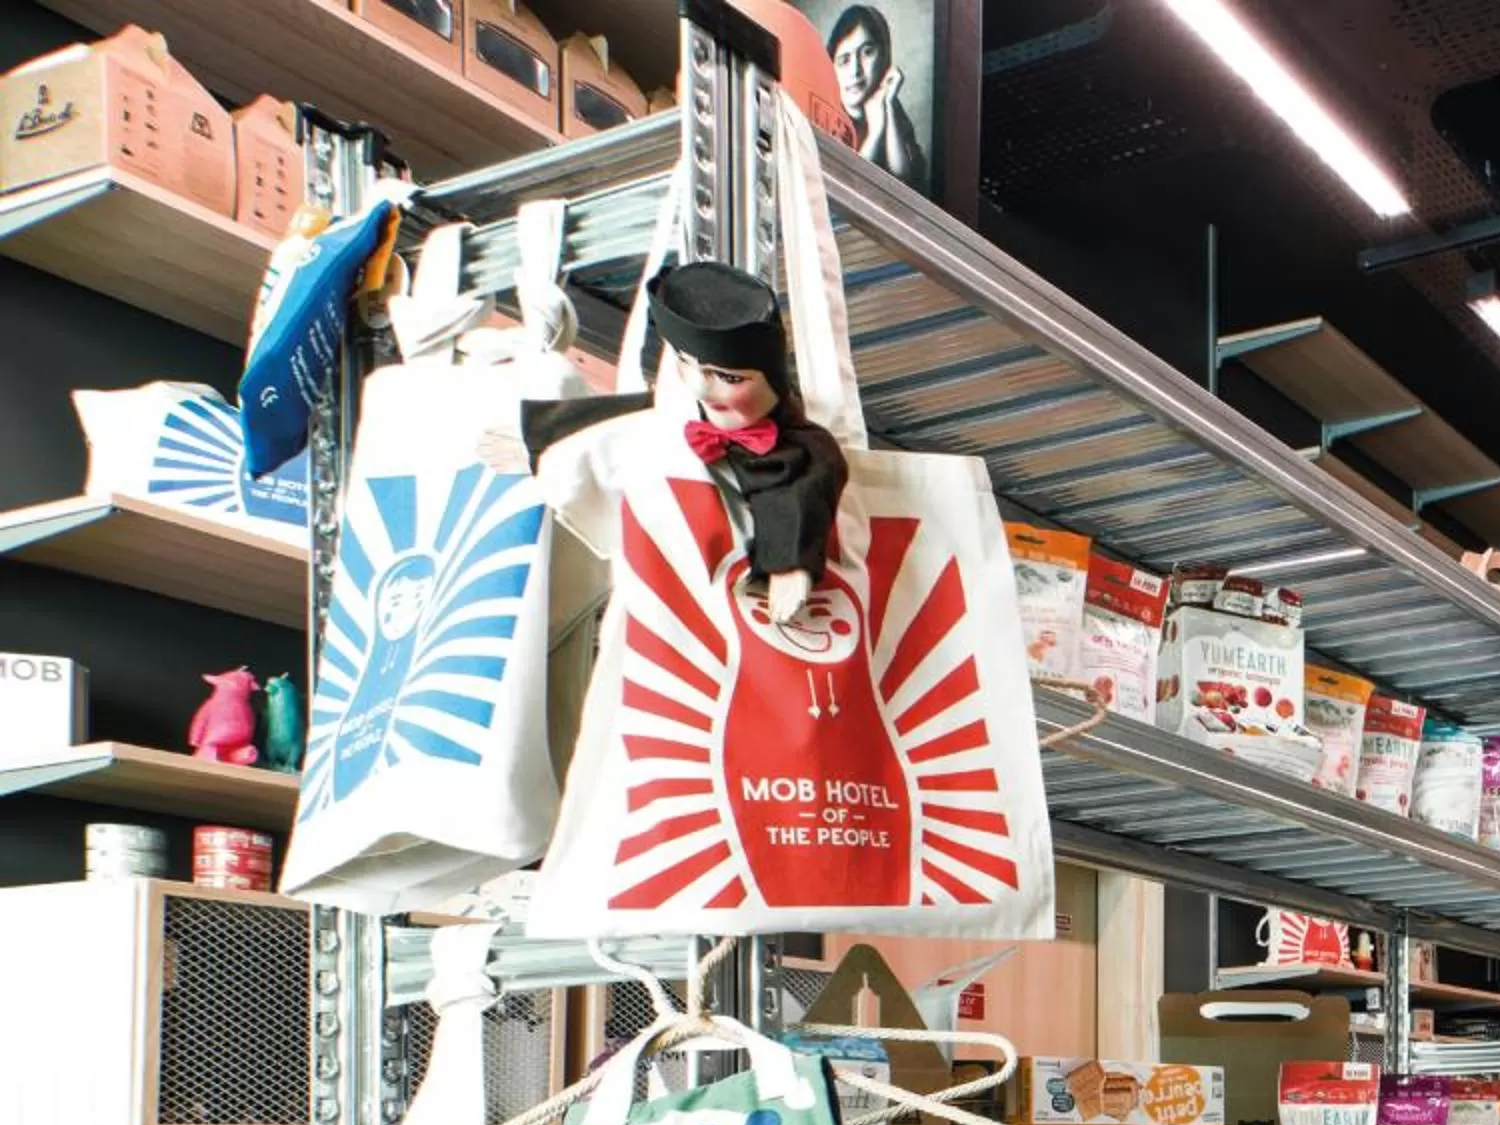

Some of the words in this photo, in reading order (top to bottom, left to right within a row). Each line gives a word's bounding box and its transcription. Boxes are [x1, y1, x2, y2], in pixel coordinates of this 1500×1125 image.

[0, 659, 62, 682] OB
[741, 776, 816, 802] MOB
[825, 780, 899, 809] HOTEL
[766, 826, 812, 846] THE
[818, 828, 891, 848] PEOPLE
